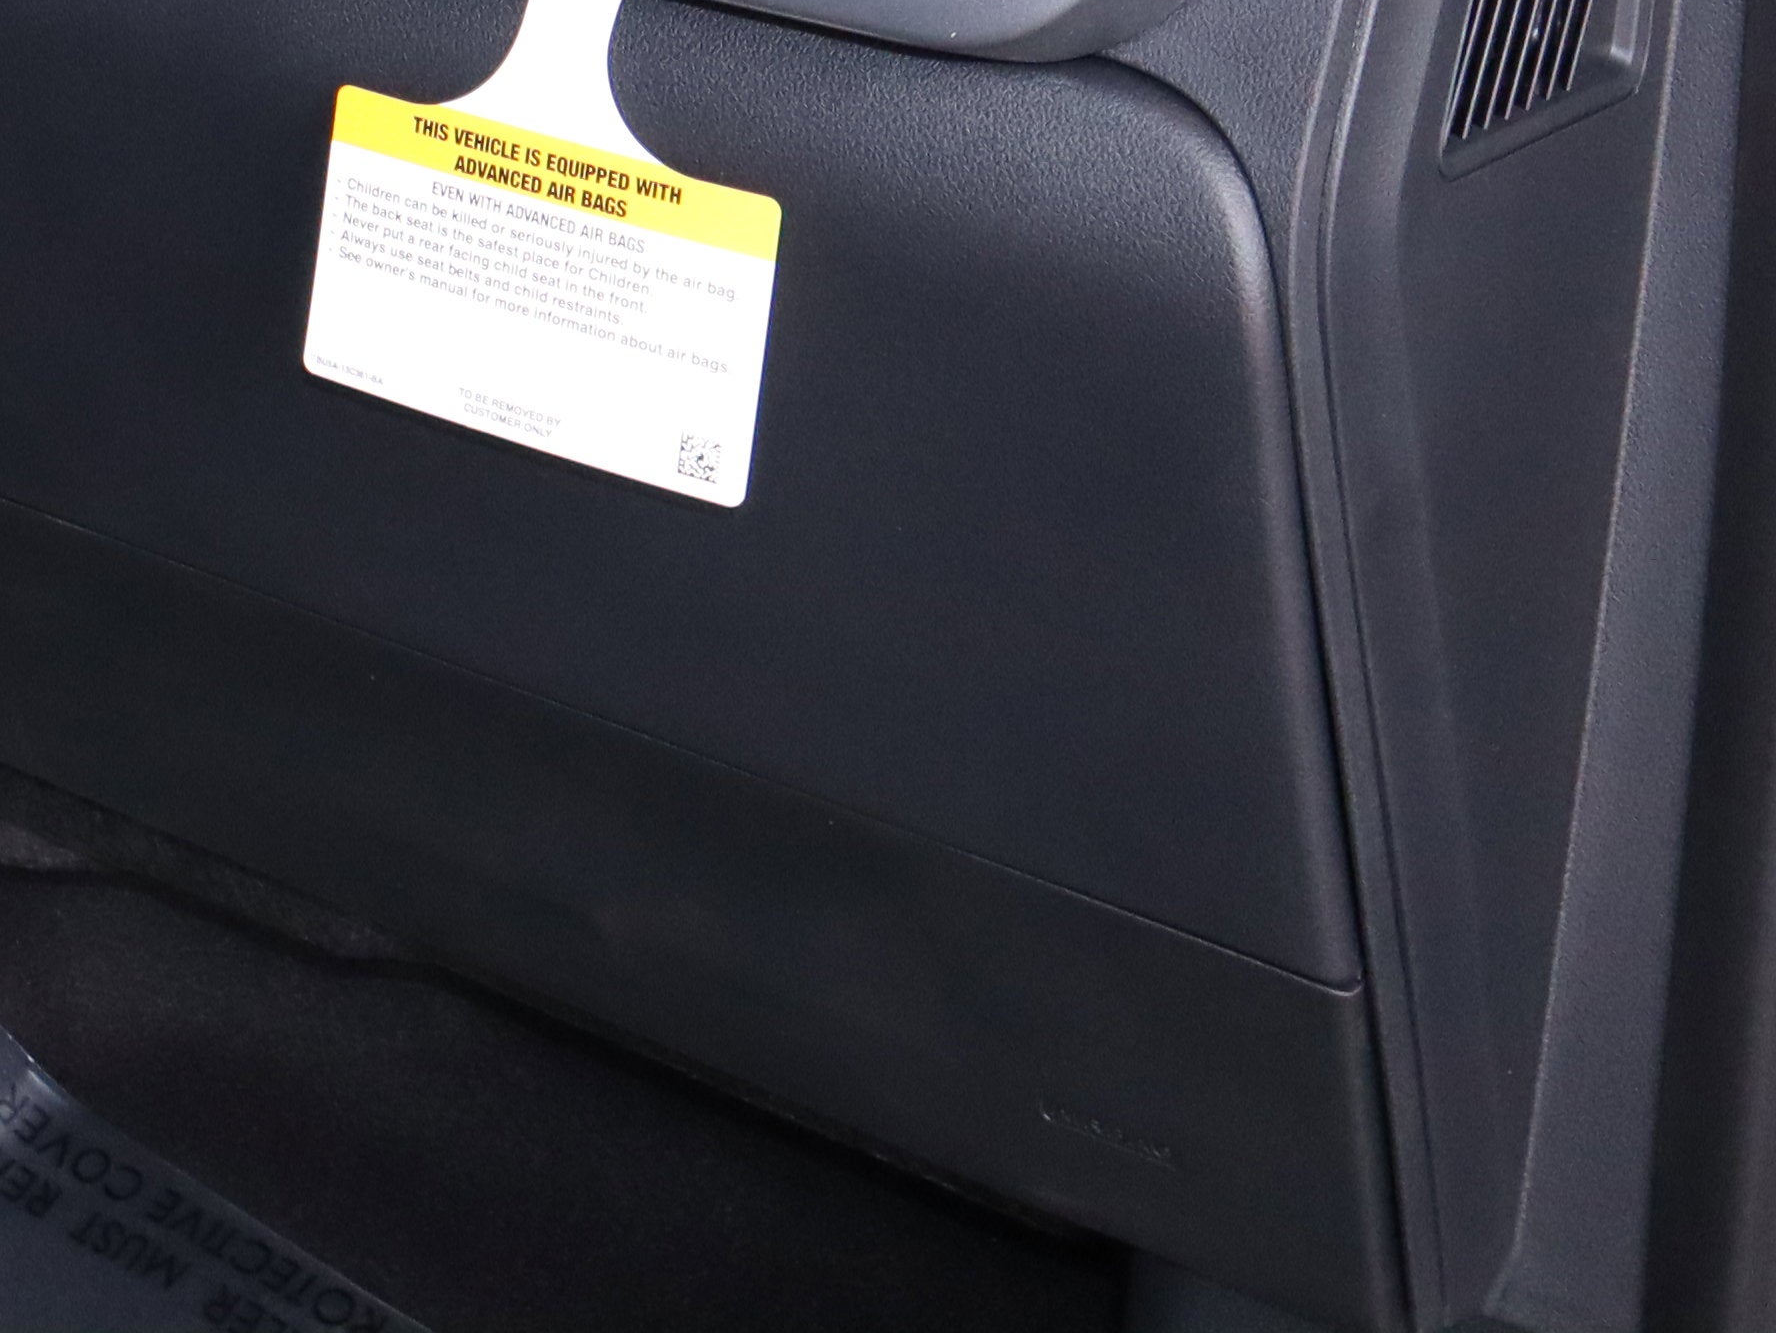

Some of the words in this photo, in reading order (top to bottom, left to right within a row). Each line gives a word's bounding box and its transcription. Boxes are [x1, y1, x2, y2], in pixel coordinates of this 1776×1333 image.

[412, 115, 449, 142] THIS
[453, 127, 520, 162] VEHICLE
[524, 146, 541, 167] IS
[545, 152, 630, 192] EQUIPPED
[634, 176, 682, 205] WITH
[454, 154, 542, 194] ADVANCED
[546, 180, 576, 204] AIR
[580, 189, 627, 218] BAGS
[344, 194, 368, 213] The
[371, 203, 402, 223] back
[405, 214, 433, 232] seat
[436, 223, 448, 237] is
[451, 227, 473, 245] the
[477, 235, 519, 258] safest
[522, 248, 559, 273] place
[563, 259, 584, 277] for
[346, 177, 400, 204] Children
[403, 197, 427, 212] can
[431, 203, 448, 218] be
[451, 209, 487, 231] killed
[491, 222, 504, 235] or
[509, 225, 573, 258] seriously
[576, 244, 628, 273] injured
[631, 260, 650, 280] by
[654, 267, 678, 284] the
[682, 274, 702, 291] air
[431, 180, 464, 203] EVEN
[468, 191, 502, 213] WITH
[505, 202, 576, 235] ADVANCED
[579, 223, 603, 243] AIR
[607, 231, 645, 254] BAGS
[338, 245, 362, 264] See
[365, 255, 415, 281] owner's
[419, 272, 467, 298] manual
[471, 287, 490, 305] for
[494, 296, 529, 317] more
[533, 306, 616, 343] information
[620, 331, 662, 356] about
[667, 345, 685, 363] air
[340, 229, 386, 256] Always
[389, 246, 413, 263] use
[416, 254, 444, 272] seat
[447, 262, 480, 283] belts
[484, 274, 510, 292] and
[514, 283, 547, 304] child
[551, 294, 624, 326] restraints.
[342, 211, 379, 233] Never
[382, 226, 404, 243] put
[418, 237, 444, 254] rear
[448, 243, 490, 271] facing
[493, 258, 527, 279] child
[531, 269, 561, 289] seat
[565, 279, 578, 294] in
[582, 283, 605, 302] the
[609, 291, 648, 314] front.
[458, 386, 472, 400] TO
[474, 392, 489, 405] BE
[491, 397, 543, 423] REMOVED
[546, 414, 561, 429] BY
[463, 402, 521, 428] CUSTOMER
[524, 421, 552, 439] ONLY
[71, 1210, 194, 1290] MUST
[147, 1189, 389, 1333] ROTECTIVE
